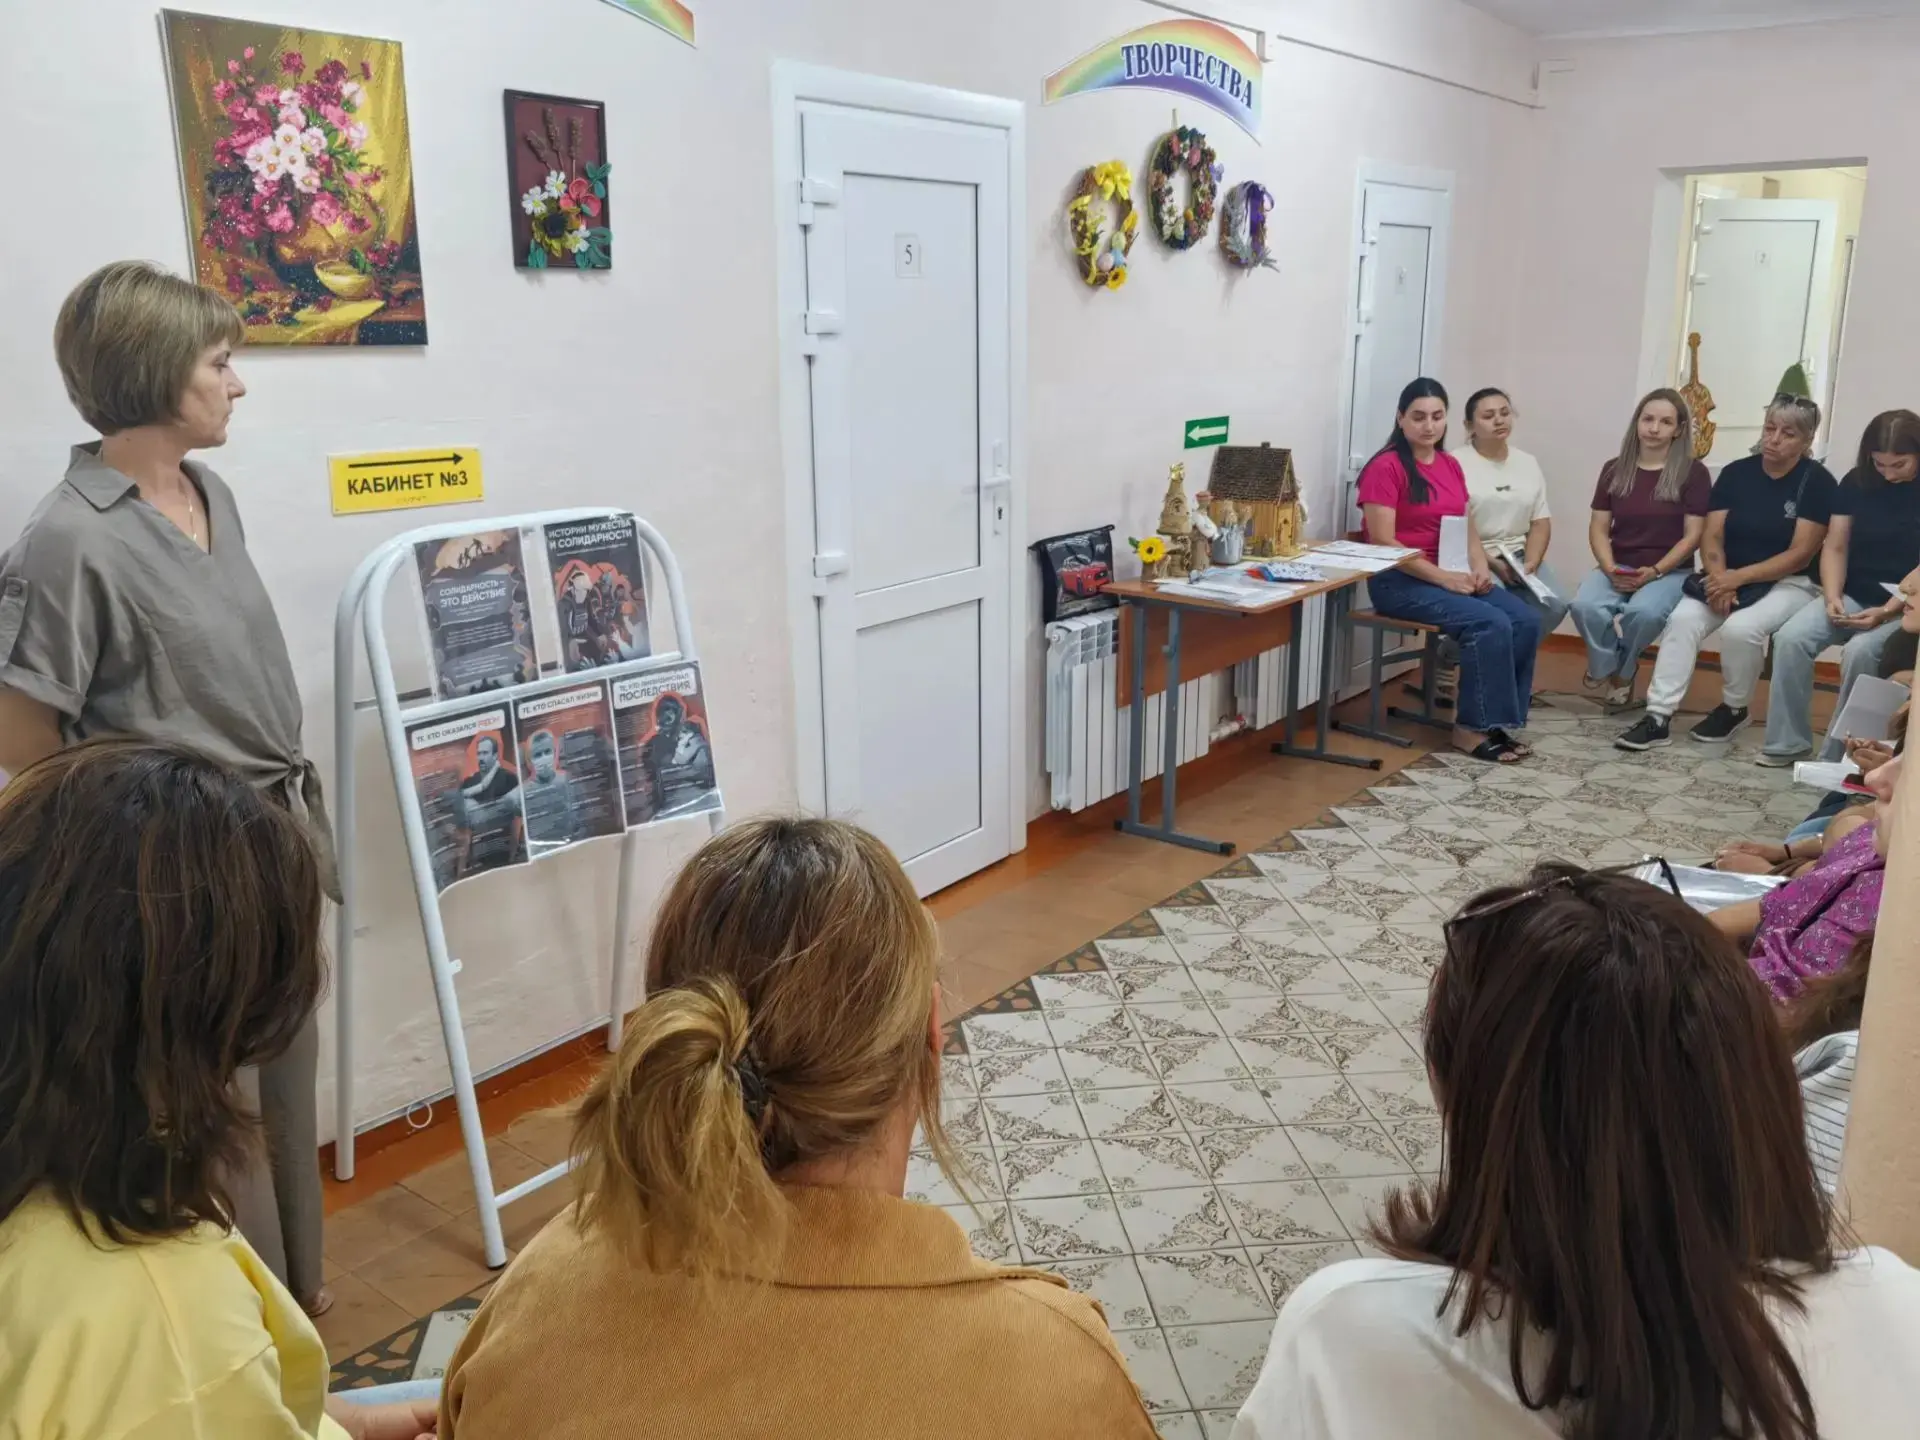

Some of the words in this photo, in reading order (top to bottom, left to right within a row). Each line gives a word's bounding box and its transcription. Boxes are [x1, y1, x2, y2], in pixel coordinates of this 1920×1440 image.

[1121, 42, 1253, 109] ТВОРЧЕСТВА
[905, 244, 913, 265] 5
[347, 473, 434, 495] КАБИНЕТ
[440, 470, 468, 487] №3
[548, 525, 587, 538] ИСТОРИИ
[588, 519, 632, 533] МУЖЕСТВА
[558, 529, 632, 548] СОЛИДАРНОСТИ
[440, 580, 499, 597] СОЛИДАРНОСТЬ
[440, 596, 460, 608] ЭТО
[461, 587, 506, 605] ДЕЙСТВИЕ
[619, 680, 691, 702] ПОСЛЕДСТВИЯ
